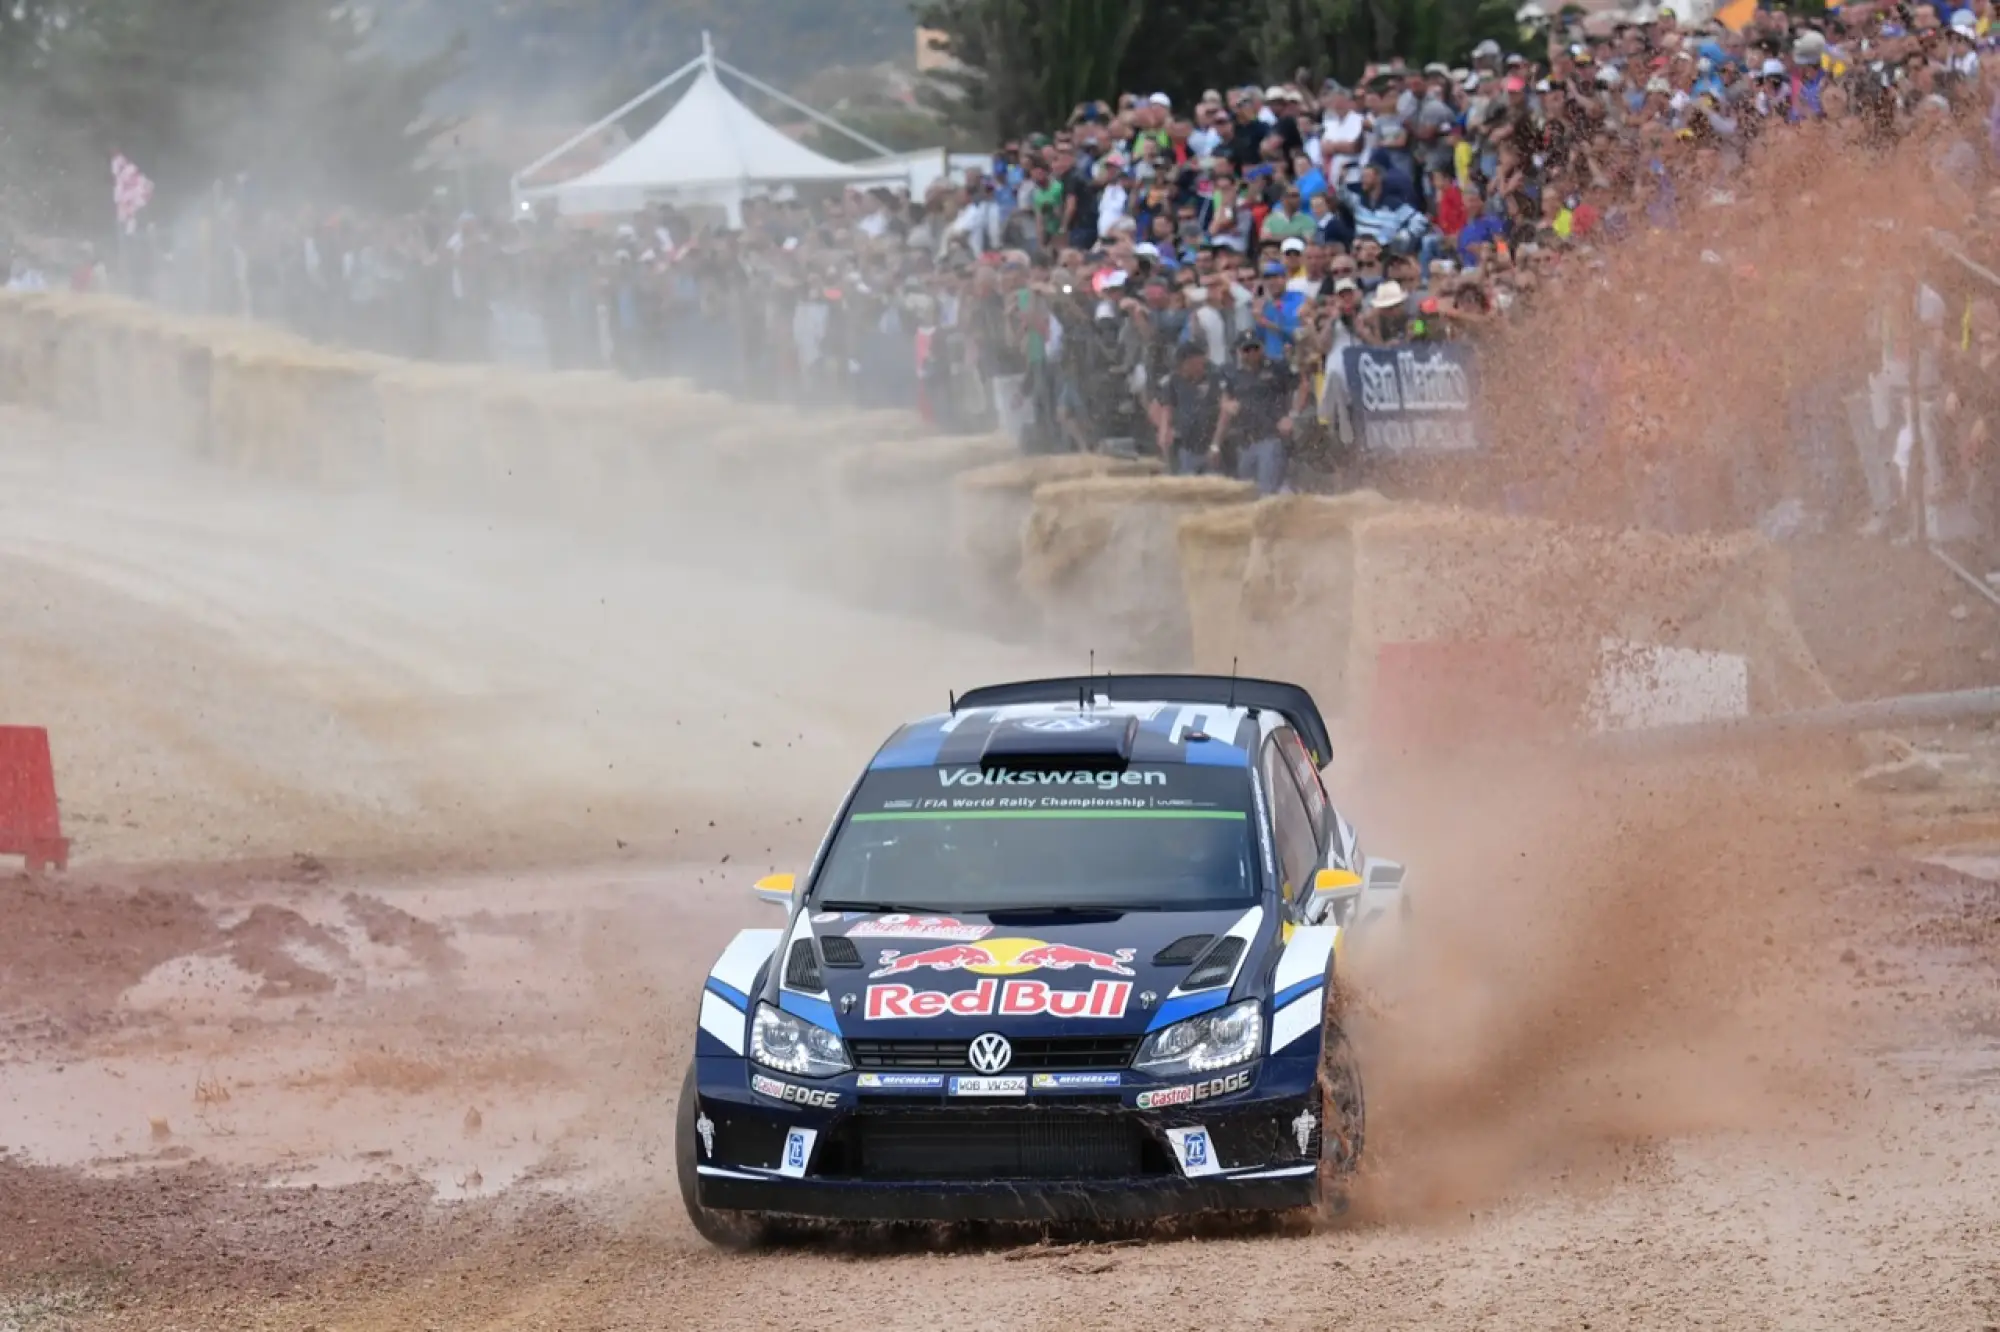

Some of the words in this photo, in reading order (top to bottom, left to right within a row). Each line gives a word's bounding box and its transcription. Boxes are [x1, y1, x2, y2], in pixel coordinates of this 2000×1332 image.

[1358, 351, 1401, 412] San
[938, 768, 1168, 790] Volkswagen
[924, 799, 948, 808] FIA
[953, 797, 995, 807] World
[1000, 797, 1036, 808] Rally
[1041, 796, 1146, 808] Championship
[866, 979, 997, 1019] Red
[1000, 980, 1132, 1018] Bull
[783, 1085, 841, 1109] EDGE
[1151, 1088, 1192, 1106] Castrol
[1195, 1071, 1250, 1099] EDGE
